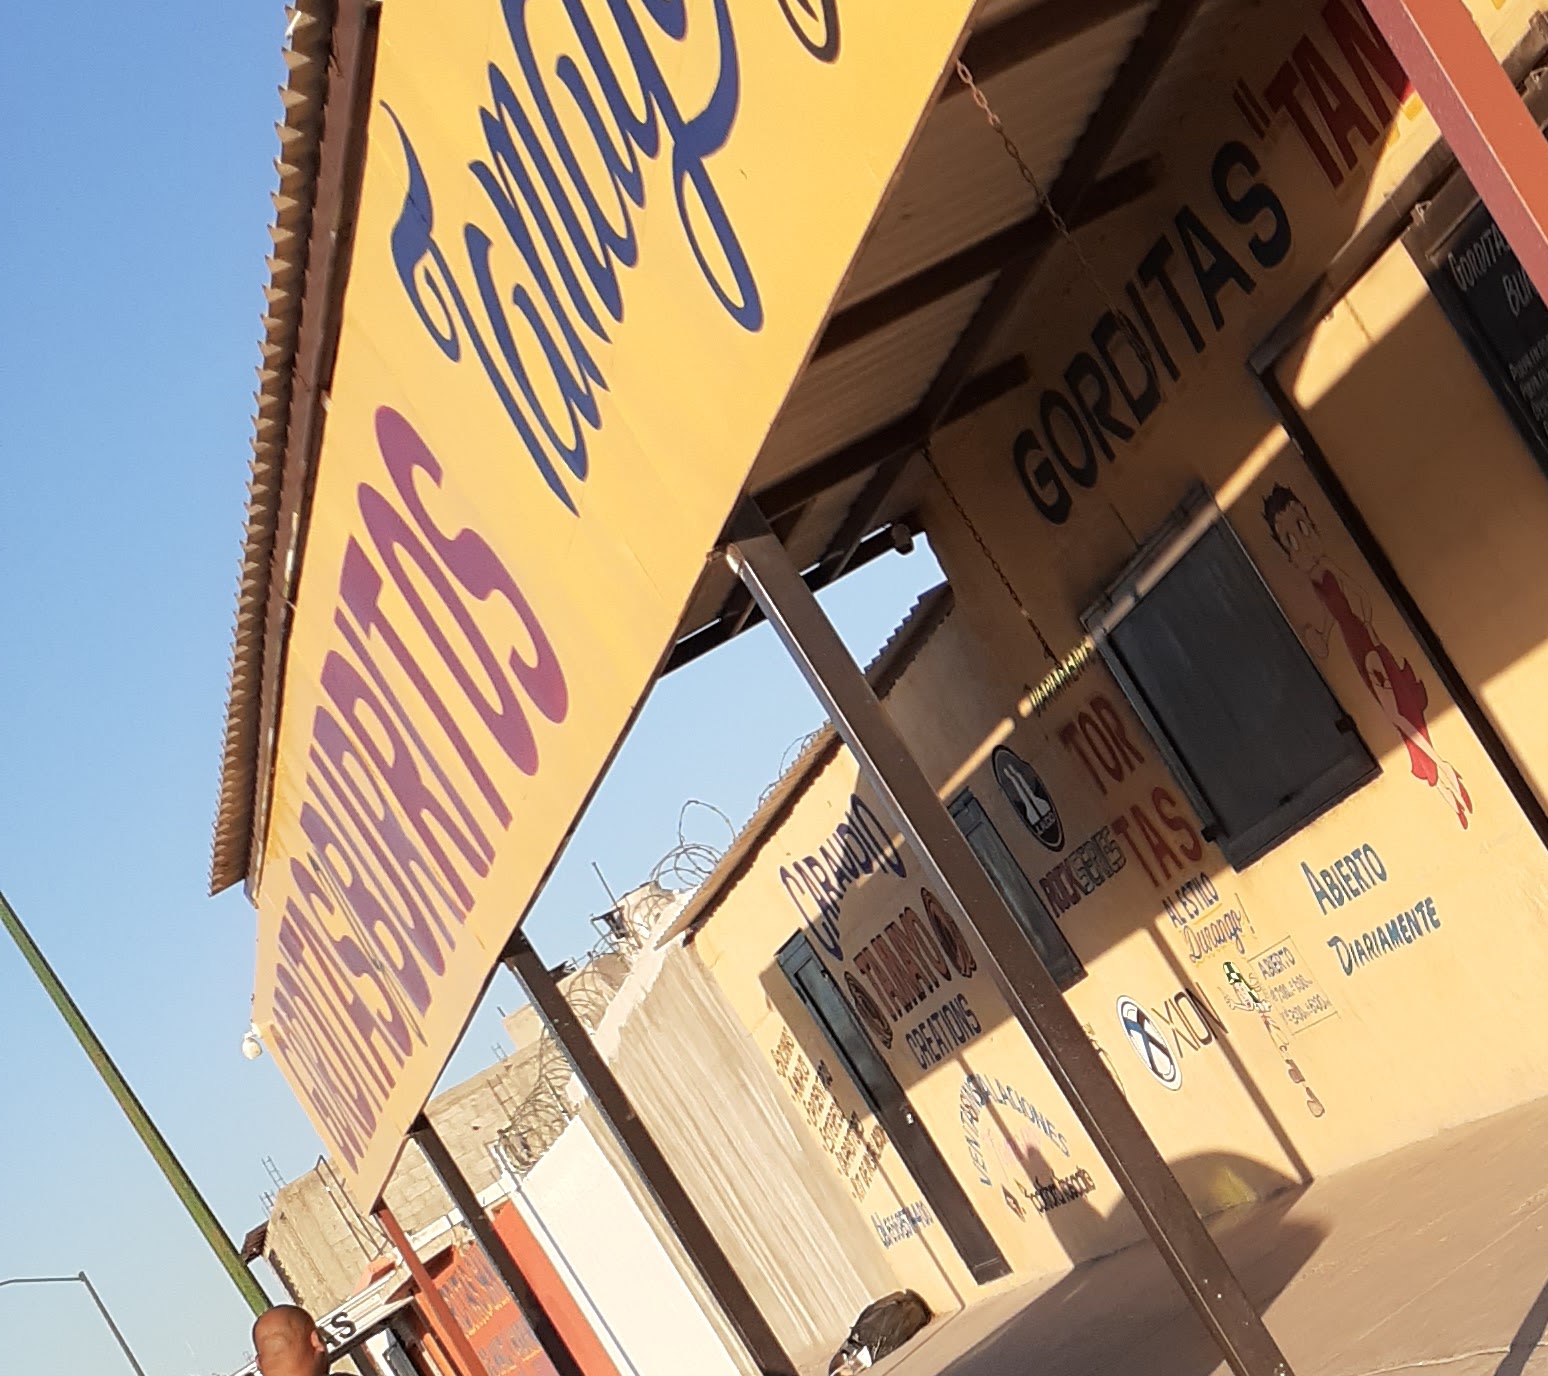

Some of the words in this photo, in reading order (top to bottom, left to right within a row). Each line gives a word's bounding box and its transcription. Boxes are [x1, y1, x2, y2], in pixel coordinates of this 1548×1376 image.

[1448, 224, 1510, 293] GORDITA
[1012, 140, 1292, 526] GORDITAS
[300, 404, 569, 1018] BURRITOS
[1058, 695, 1146, 796] TOR
[1110, 785, 1203, 888] TAS
[1300, 842, 1388, 916] ABIERTO
[1174, 870, 1220, 921] ESTILO
[1326, 896, 1442, 977] DIARIAMENTE
[270, 856, 413, 1175] GORDITAS
[904, 992, 983, 1070] CREATIONS
